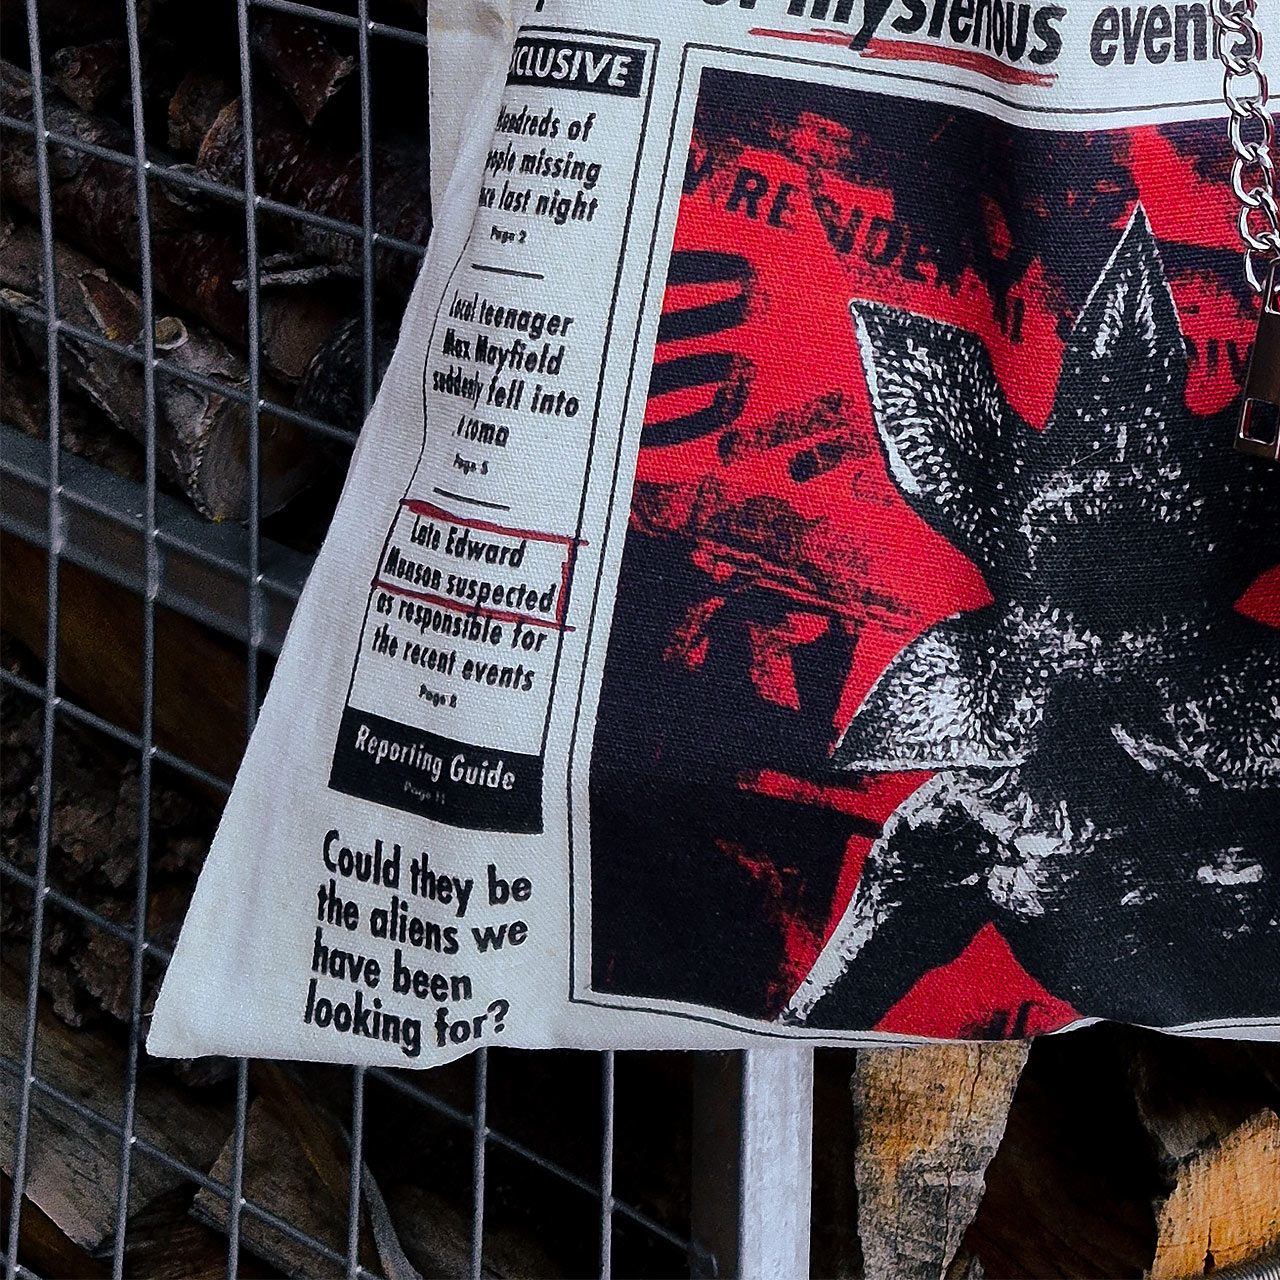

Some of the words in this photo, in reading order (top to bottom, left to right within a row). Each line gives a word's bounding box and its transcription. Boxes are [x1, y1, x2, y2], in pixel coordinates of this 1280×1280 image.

[567, 112, 597, 142] of
[519, 148, 601, 189] missing
[499, 180, 532, 213] last
[536, 189, 598, 225] night
[480, 298, 574, 340] teenager
[443, 327, 470, 360] Max
[475, 334, 565, 376] Mayfield
[433, 365, 484, 410] suddenly
[487, 375, 524, 411] fell
[531, 384, 579, 418] into
[410, 515, 440, 551] Late
[445, 527, 526, 568] Edward
[384, 546, 442, 590] Munson
[446, 575, 556, 614] suspected
[376, 592, 393, 614] as
[399, 593, 502, 645] responsible
[511, 620, 548, 652] for
[371, 624, 399, 658] the
[402, 642, 456, 676] recent
[461, 659, 535, 692] events
[418, 683, 446, 708] Page
[354, 724, 443, 783] Reporting
[450, 754, 516, 791] Guide
[323, 829, 401, 889] Could
[410, 852, 474, 917] they
[487, 863, 532, 906] be
[317, 878, 360, 931] the
[370, 895, 459, 954] aliens
[471, 920, 529, 953] we
[311, 926, 381, 989] have
[392, 948, 472, 1002] been
[303, 978, 422, 1057] looking
[434, 998, 510, 1048] for?
